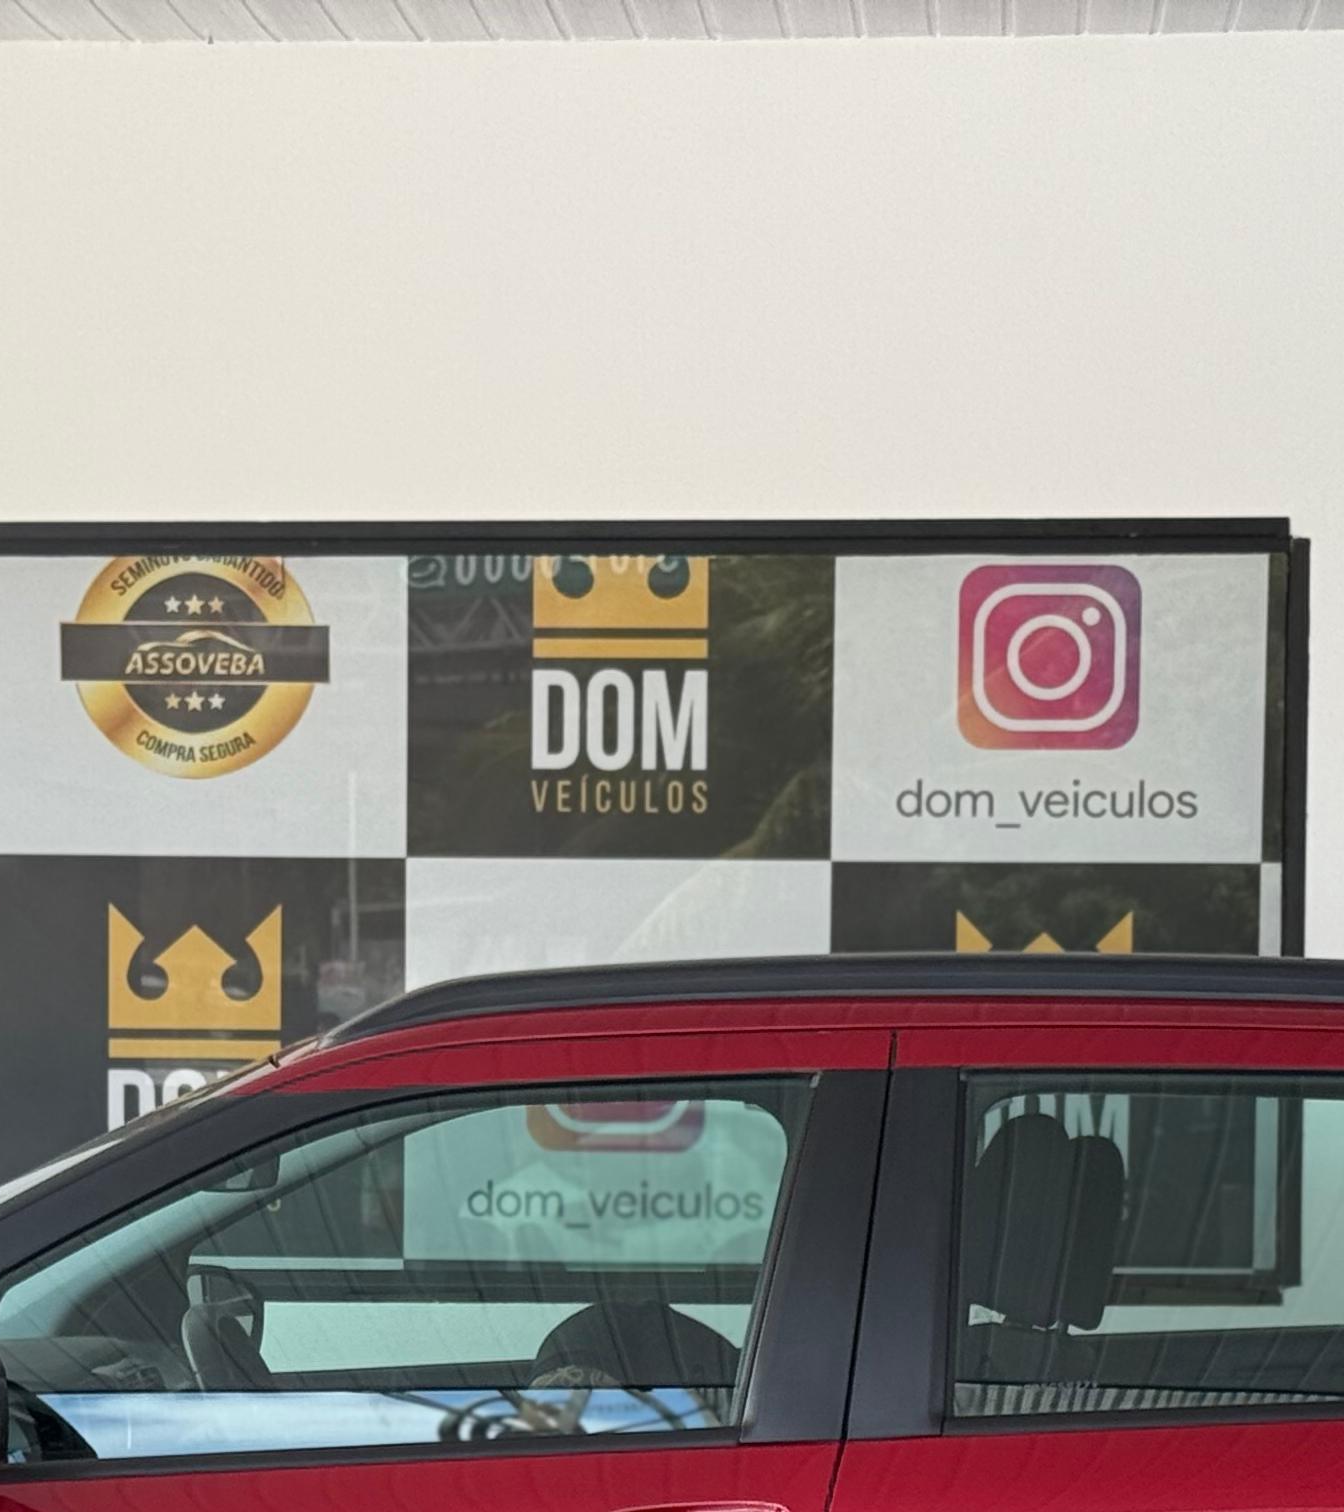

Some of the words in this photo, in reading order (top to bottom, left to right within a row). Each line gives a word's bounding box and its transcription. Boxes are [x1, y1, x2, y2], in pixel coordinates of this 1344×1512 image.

[124, 652, 266, 675] ASSOVEBA
[531, 669, 709, 771] DOM
[136, 729, 196, 763] COMPRA
[199, 731, 257, 763] SEGURA
[531, 774, 709, 814] VEÍCULOS
[896, 778, 1199, 829] dom_veiculos
[467, 1179, 764, 1230] dom_veiculos
